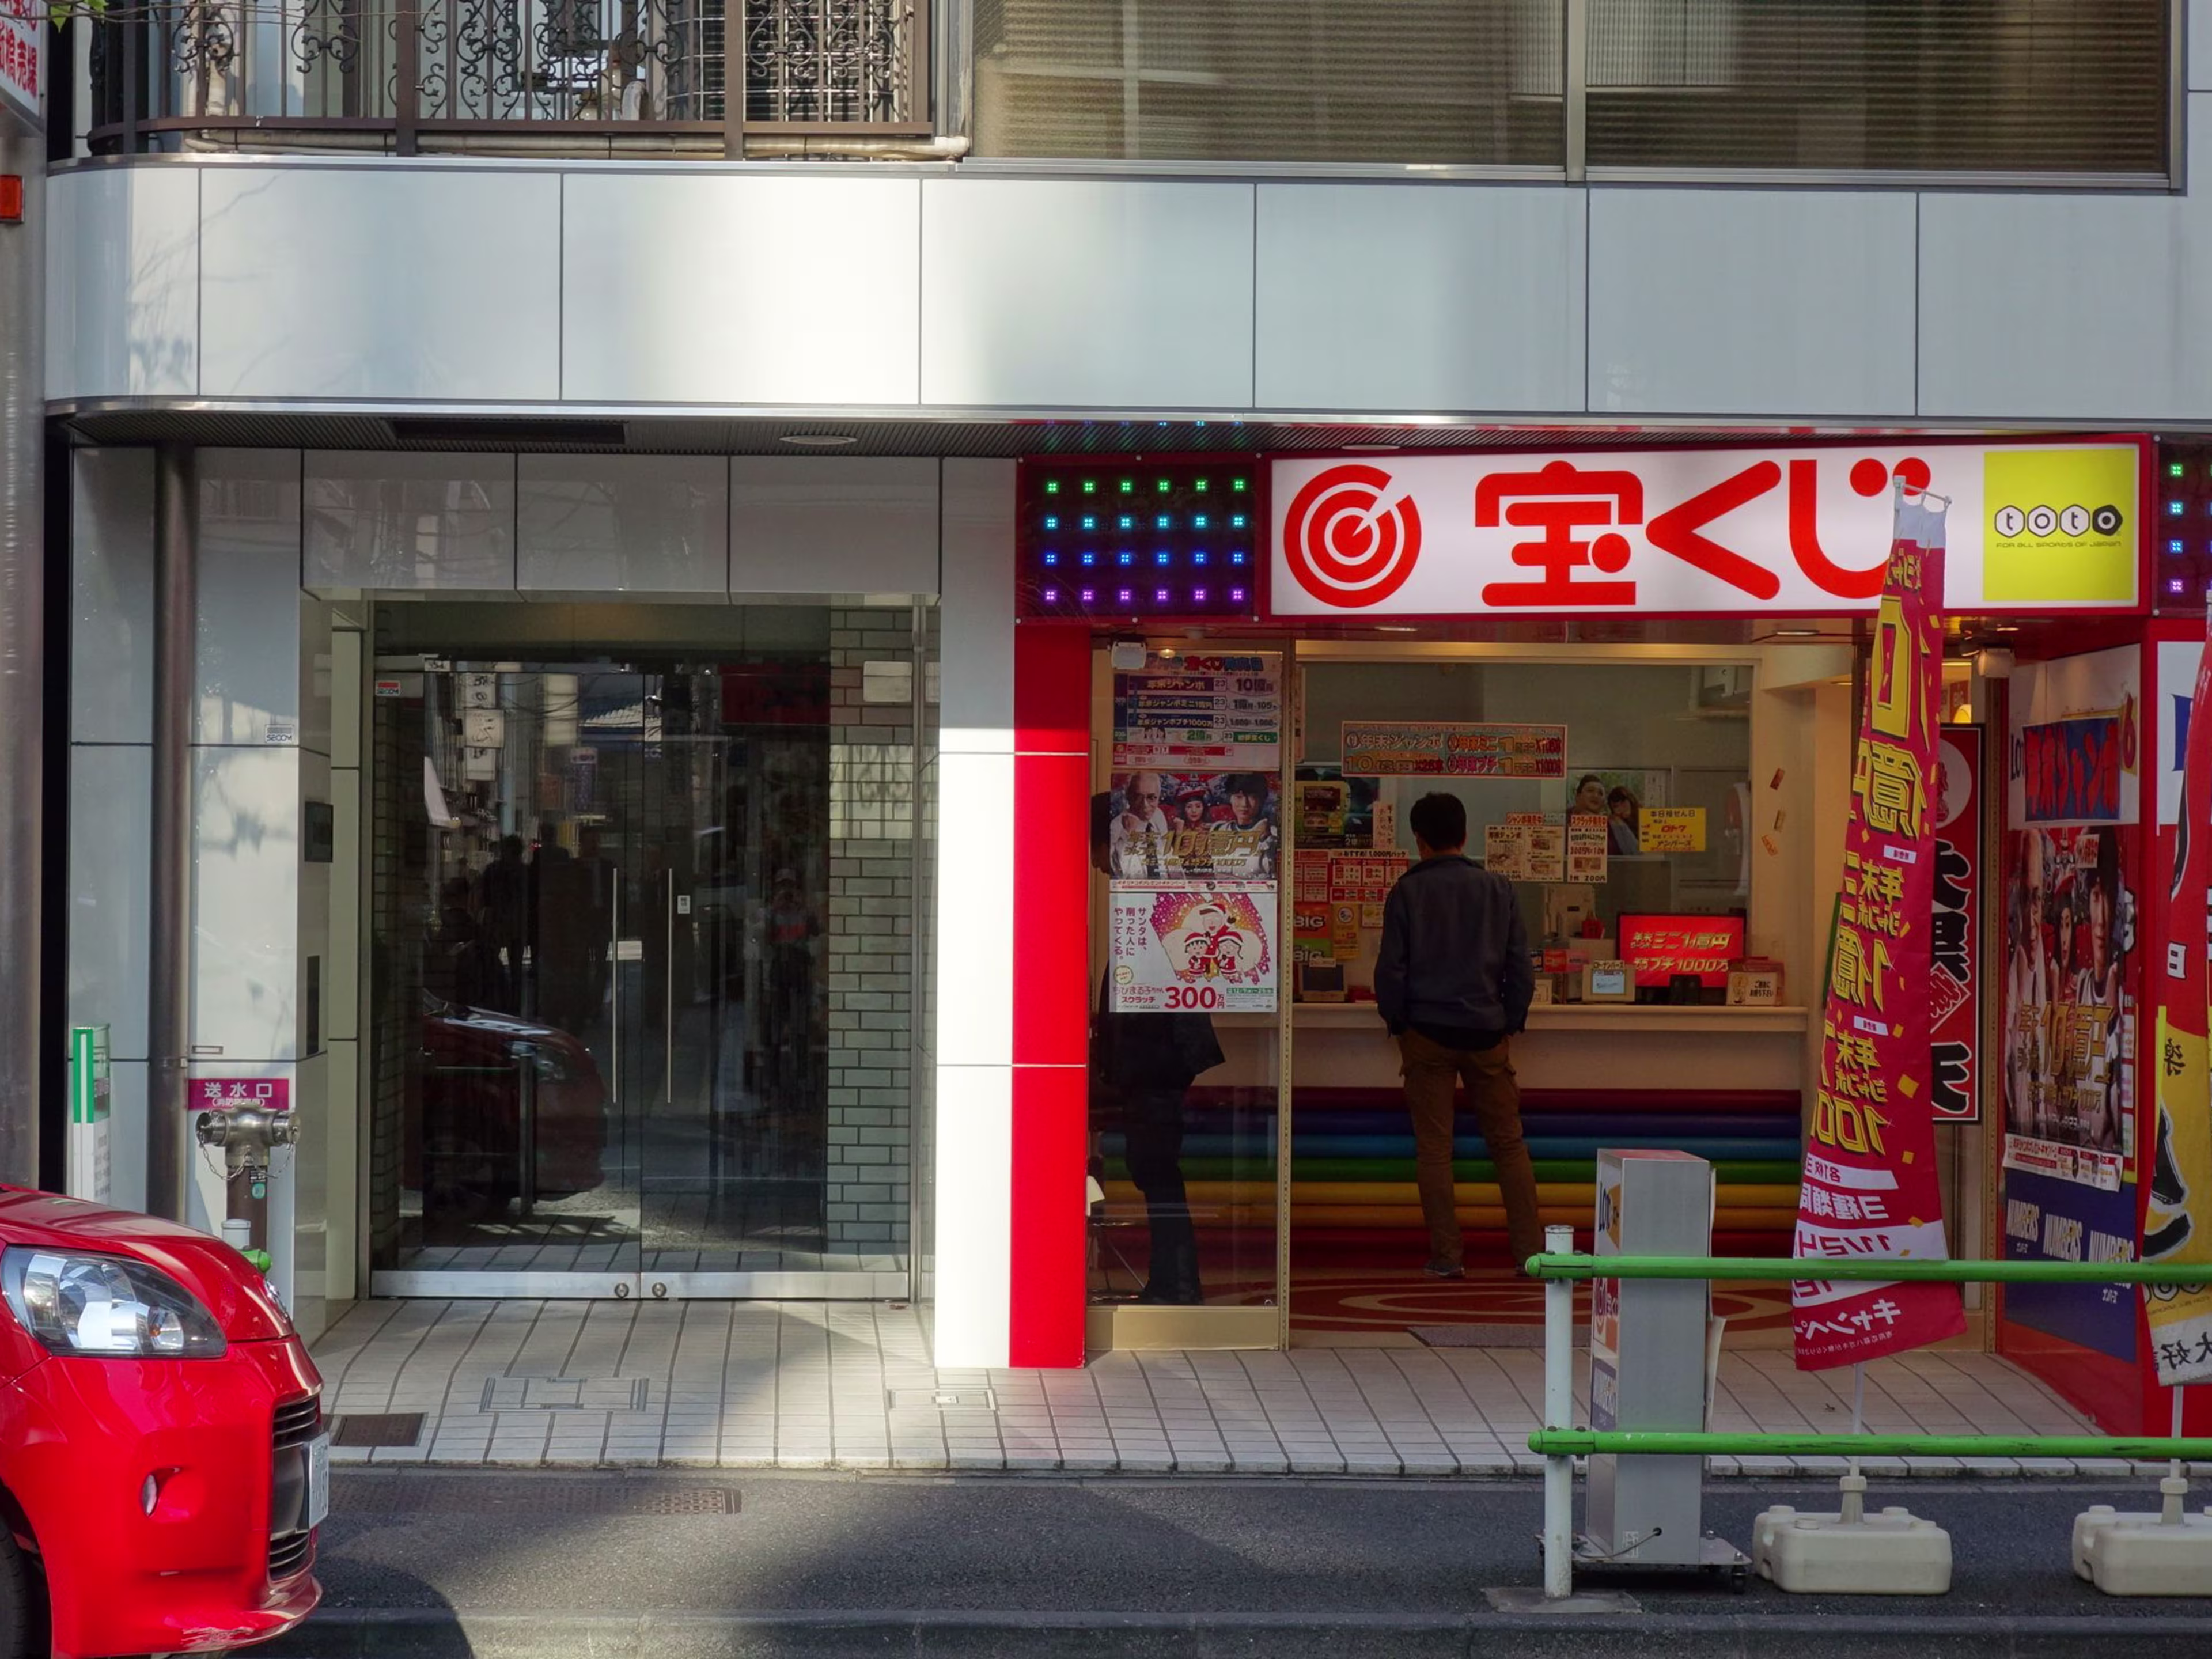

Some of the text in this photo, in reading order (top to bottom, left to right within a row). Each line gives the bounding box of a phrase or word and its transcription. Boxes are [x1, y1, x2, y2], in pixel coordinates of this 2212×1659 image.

[1475, 457, 1931, 607] 宝くじ
[1995, 505, 2123, 538] toto
[1115, 908, 1123, 960] やってくる。
[1138, 907, 1147, 951] サンタは、
[1164, 986, 1217, 1009] 300
[204, 1082, 273, 1098] 送水口
